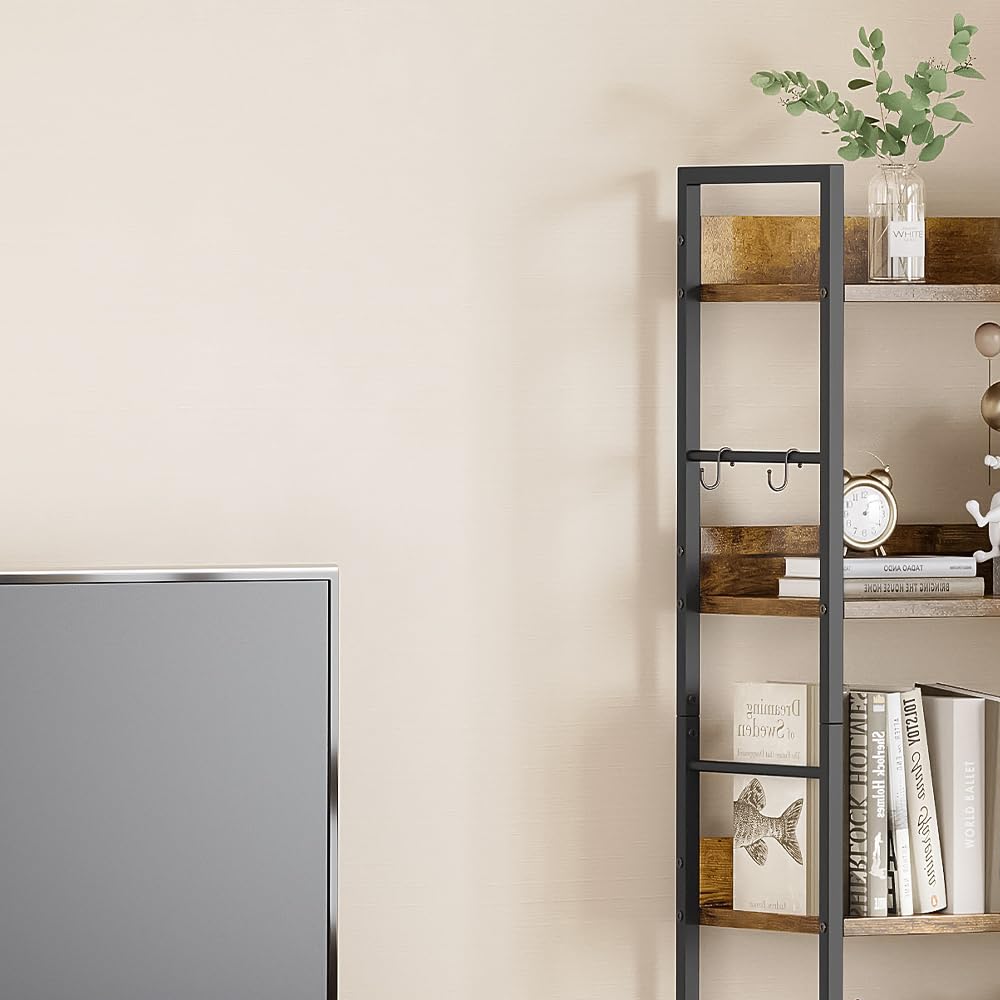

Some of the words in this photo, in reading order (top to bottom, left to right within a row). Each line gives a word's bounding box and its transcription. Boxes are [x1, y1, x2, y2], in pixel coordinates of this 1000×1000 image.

[892, 230, 923, 239] WHITE
[964, 760, 976, 802] BALLET
[964, 805, 976, 849] WORLD
